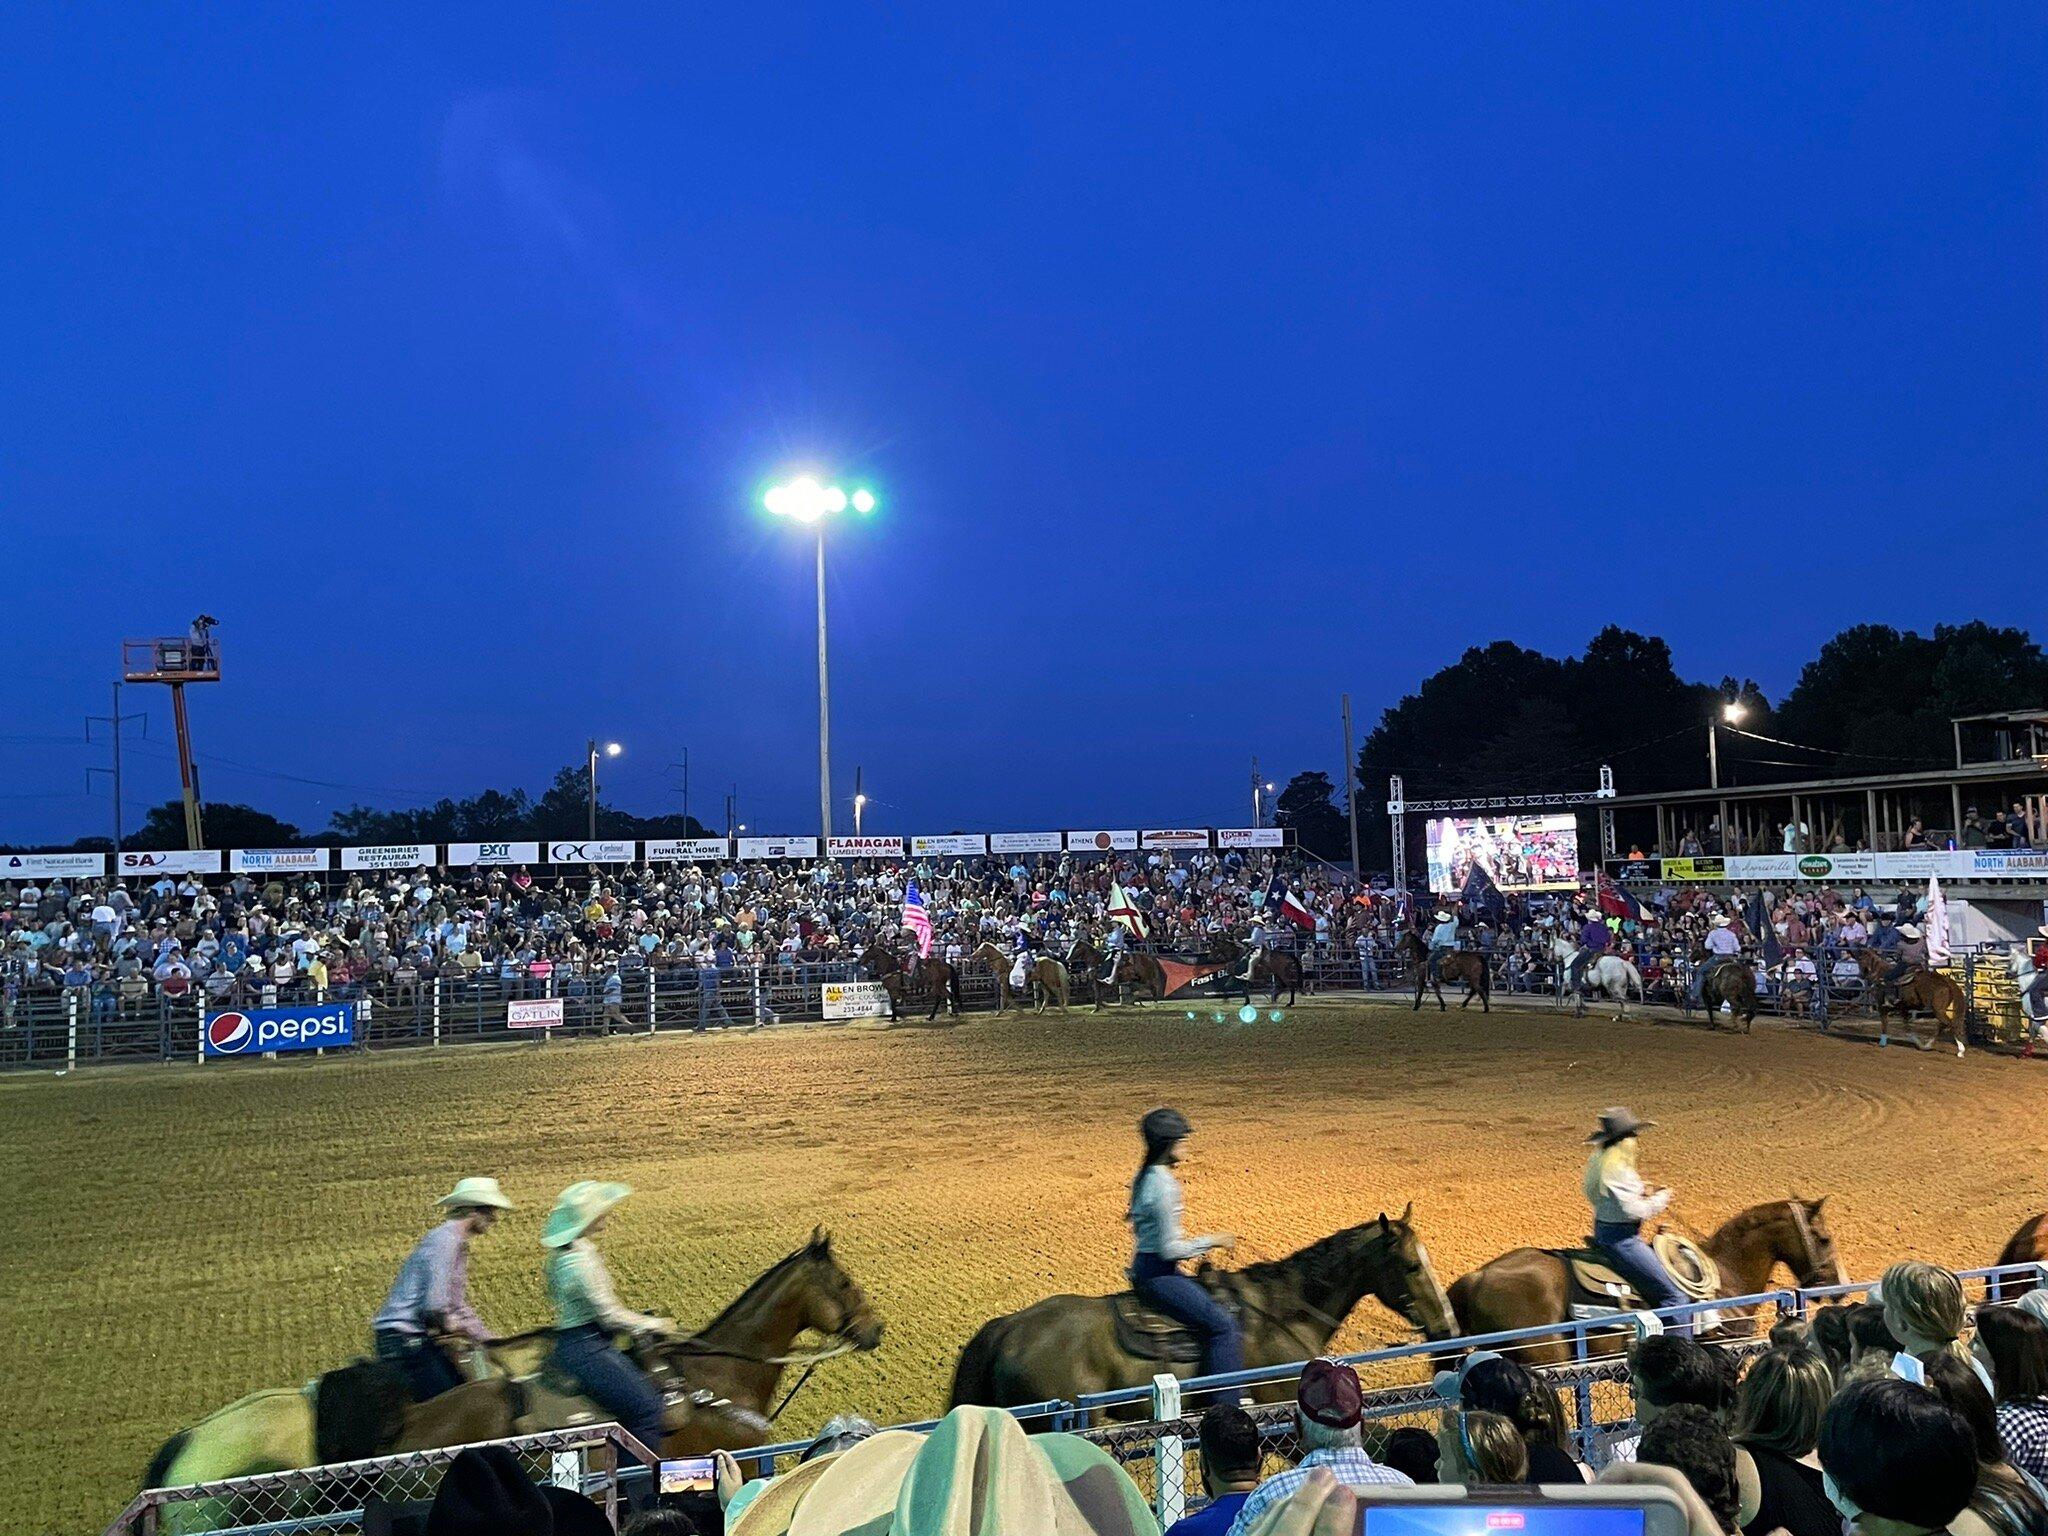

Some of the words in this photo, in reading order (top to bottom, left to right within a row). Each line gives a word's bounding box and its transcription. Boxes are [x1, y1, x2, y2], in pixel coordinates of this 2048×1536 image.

[829, 839, 901, 847] FLANAGAN
[359, 847, 419, 855] GREENBRIER
[480, 844, 510, 857] EXIT
[124, 853, 156, 867] SA
[242, 855, 272, 865] NORTH
[274, 855, 318, 864] ALABAMA
[358, 853, 420, 862] RESTAURANT
[1974, 857, 2004, 869] NORTH
[2006, 856, 2048, 868] ALABAMA
[1191, 973, 1214, 987] Fast
[826, 986, 854, 994] ALLEN
[511, 1010, 560, 1020] GATLIN
[258, 1010, 346, 1046] pepsi
